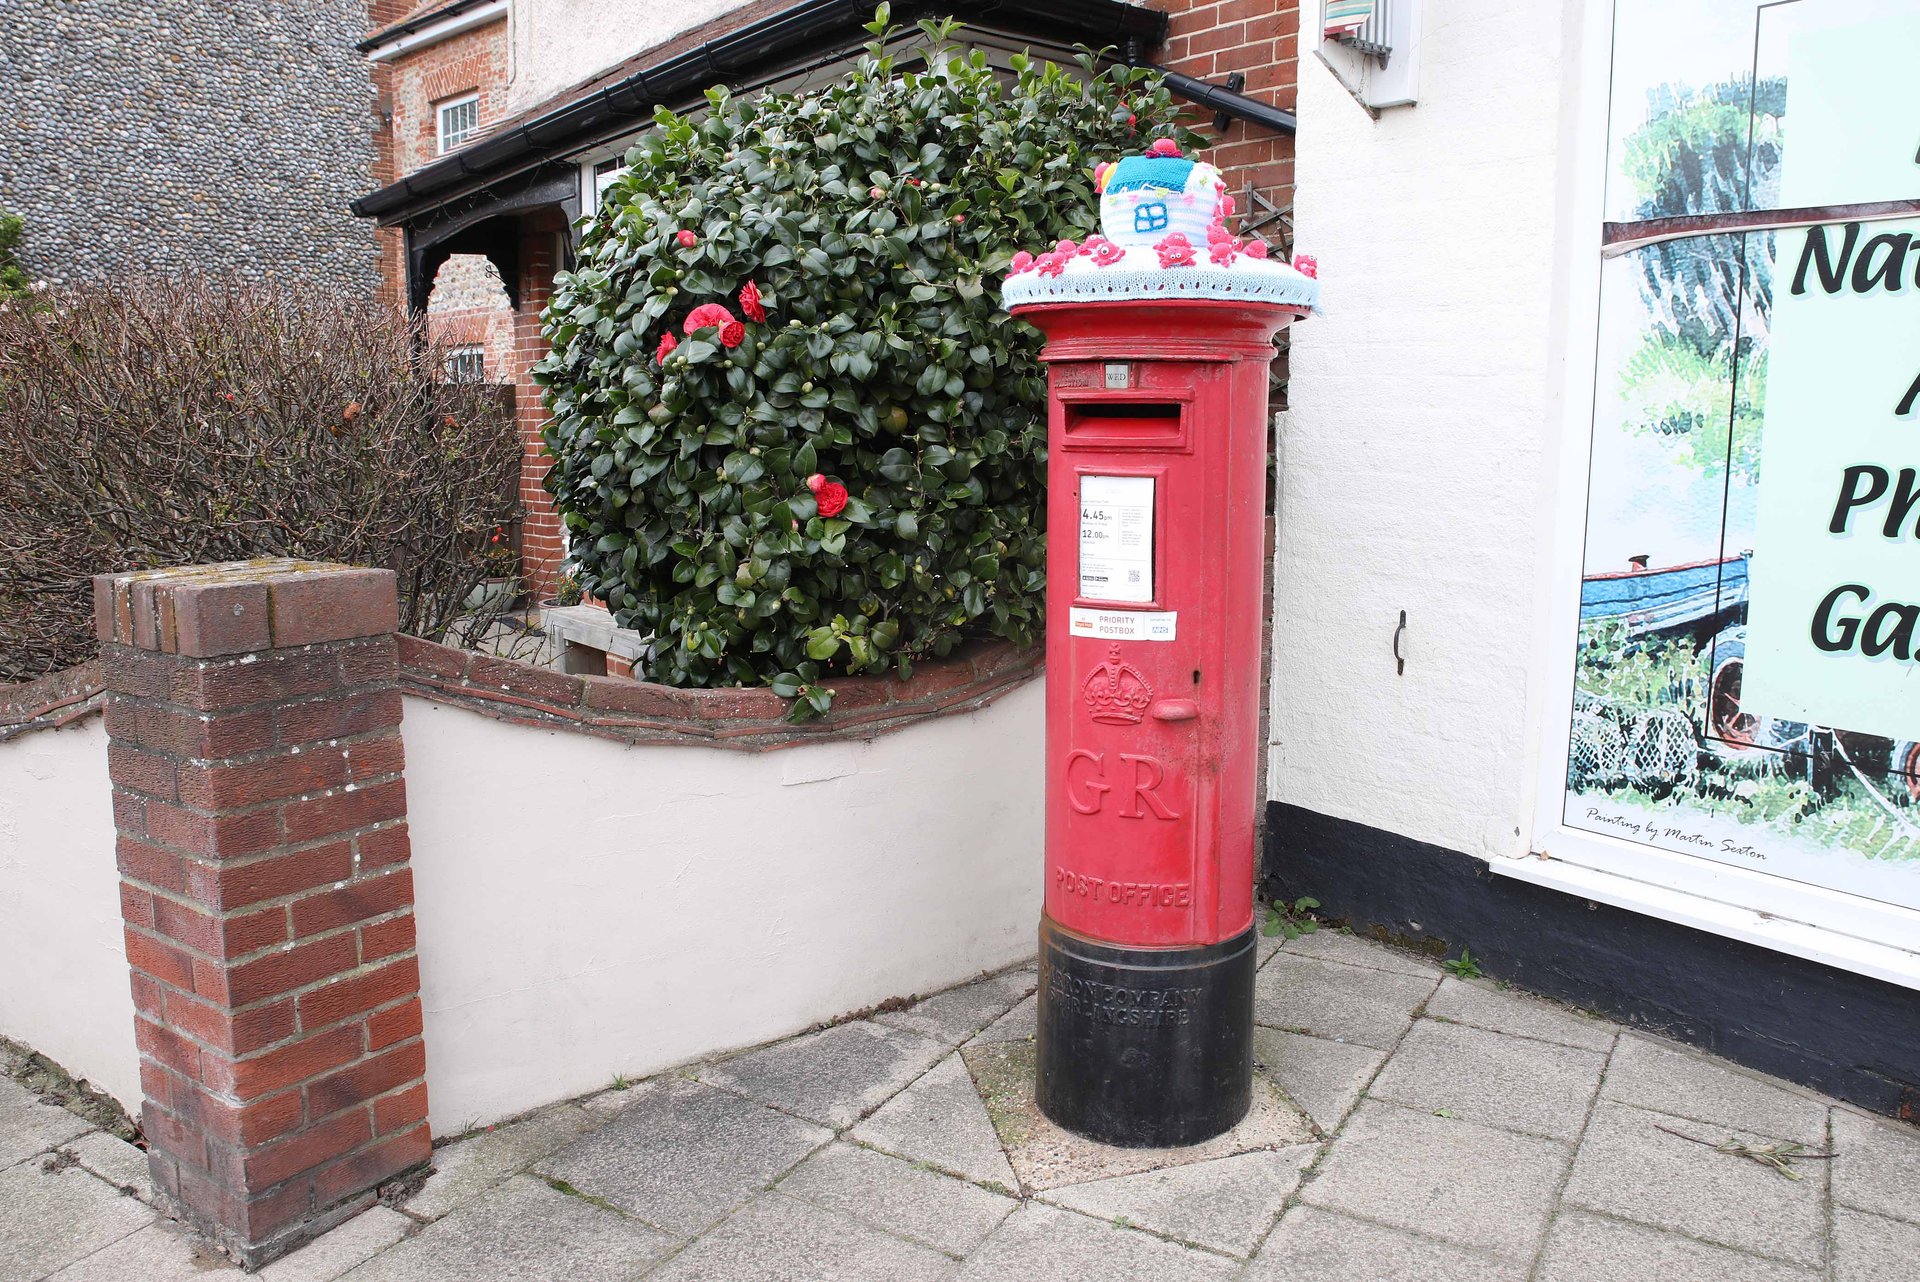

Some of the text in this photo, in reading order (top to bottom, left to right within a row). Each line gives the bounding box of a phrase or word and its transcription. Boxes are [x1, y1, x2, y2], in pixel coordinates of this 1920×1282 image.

[1106, 373, 1127, 381] WED
[1099, 616, 1135, 624] PRIORITY
[1099, 626, 1135, 635] POSTBOX
[1809, 584, 1920, 662] Ga
[1586, 807, 1767, 861] Painting by Martin Sexton
[1056, 865, 1190, 907] POST OFFICE
